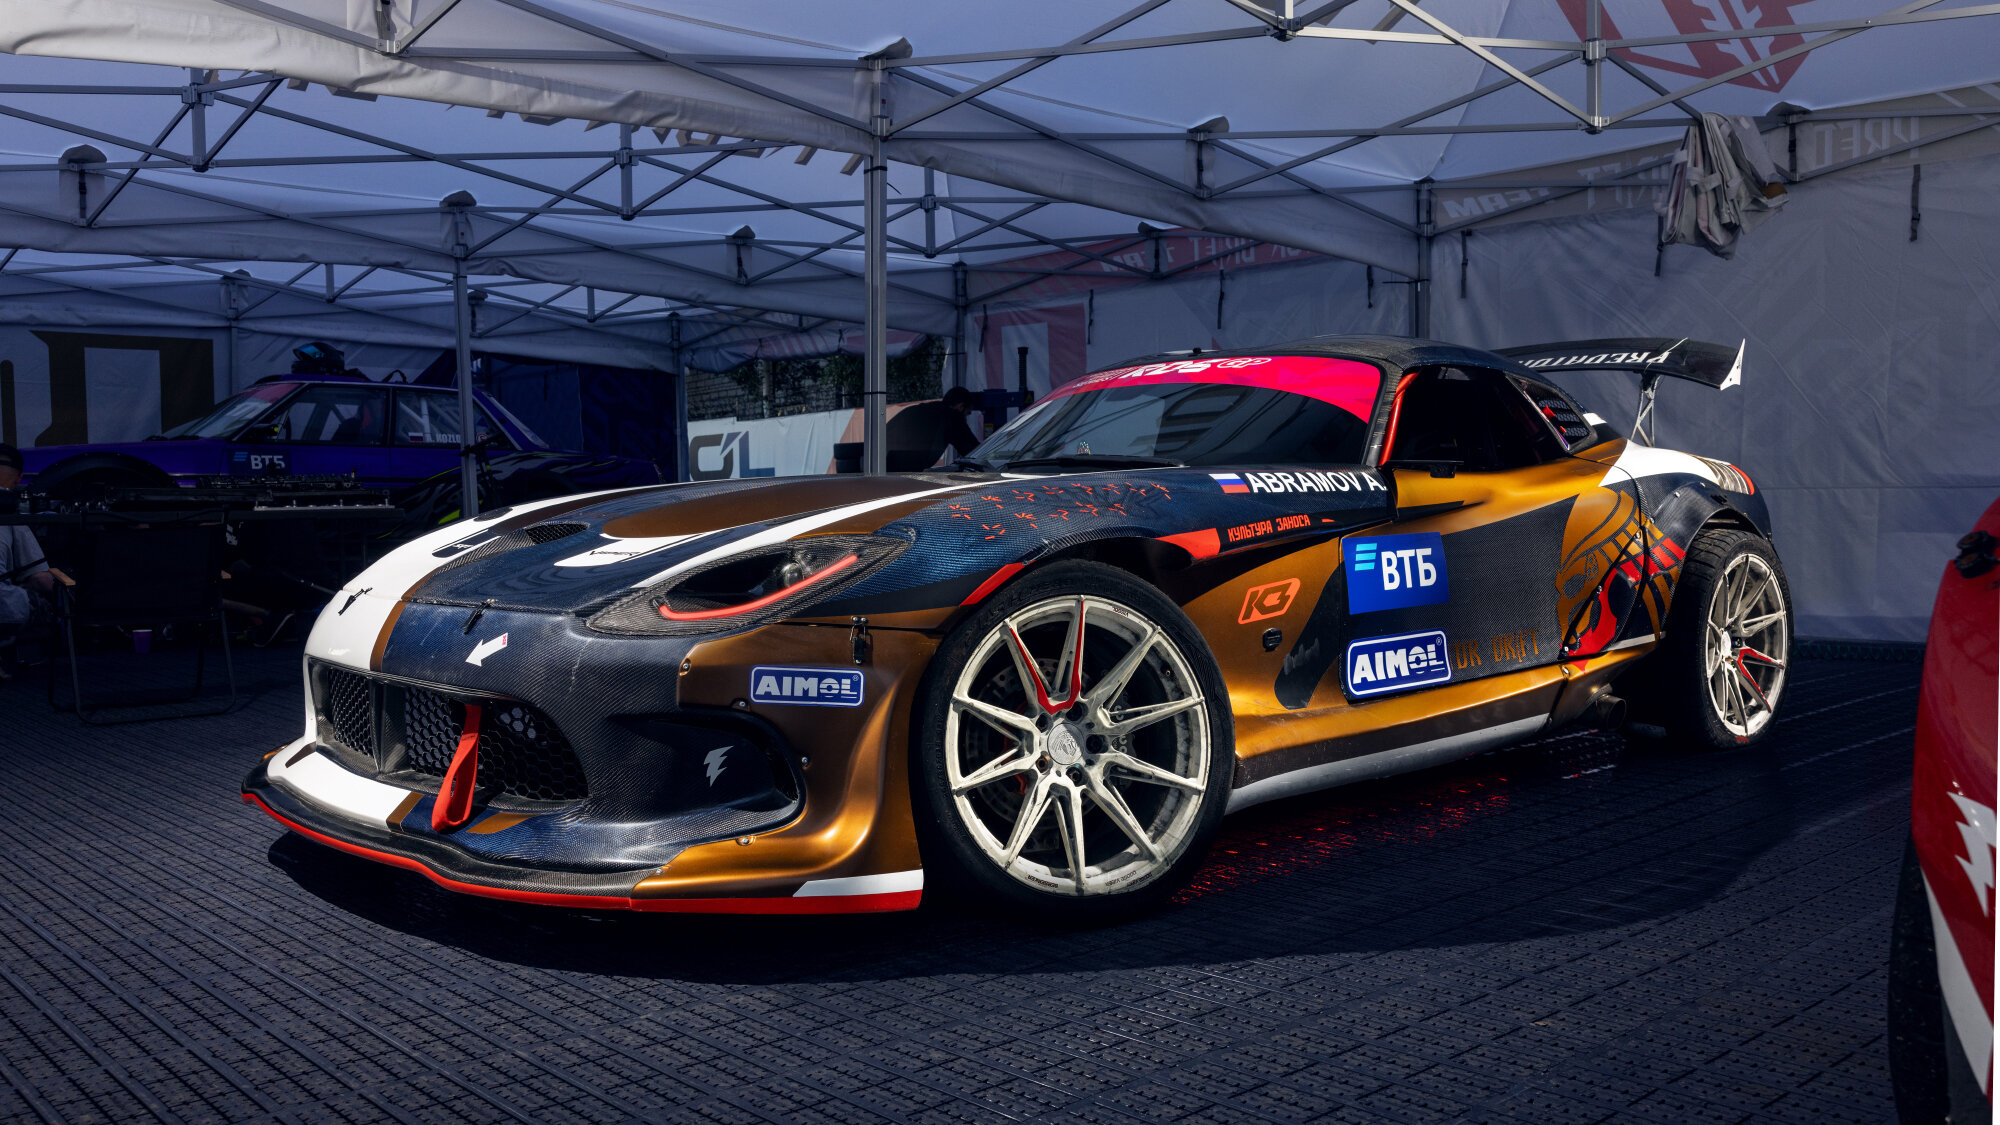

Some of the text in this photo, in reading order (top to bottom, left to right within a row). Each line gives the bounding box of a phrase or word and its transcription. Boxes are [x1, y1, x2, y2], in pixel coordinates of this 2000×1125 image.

[1244, 471, 1389, 493] ABRAMOV A.
[1227, 514, 1312, 543] КУЛЬТУРА ЗАНОСА
[1381, 547, 1437, 591] ВТБ
[1491, 628, 1541, 663] DRIFT
